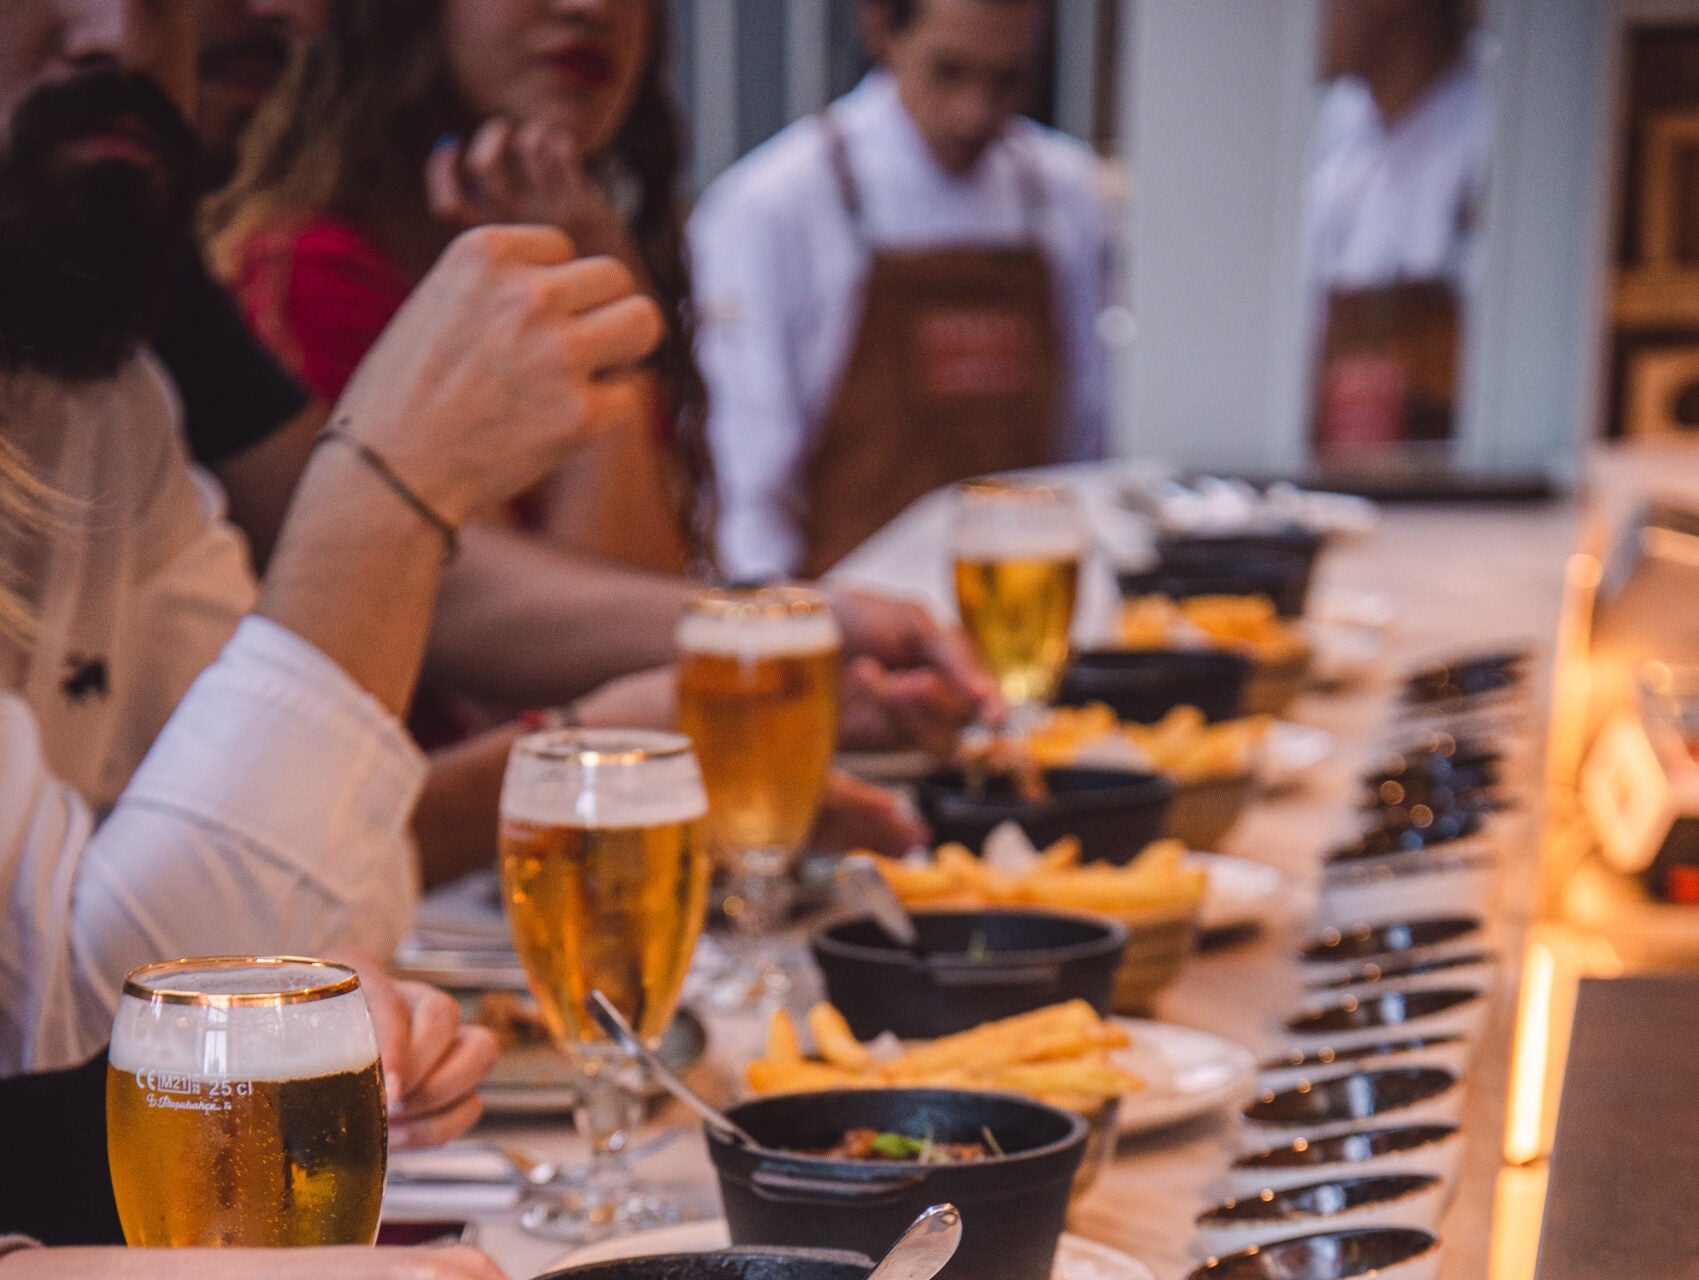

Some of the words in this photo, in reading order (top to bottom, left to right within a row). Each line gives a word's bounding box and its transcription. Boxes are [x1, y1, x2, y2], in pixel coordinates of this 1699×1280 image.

[135, 1068, 156, 1090] CE
[161, 1073, 188, 1090] M21
[208, 1080, 232, 1096] 25
[236, 1080, 253, 1096] cl
